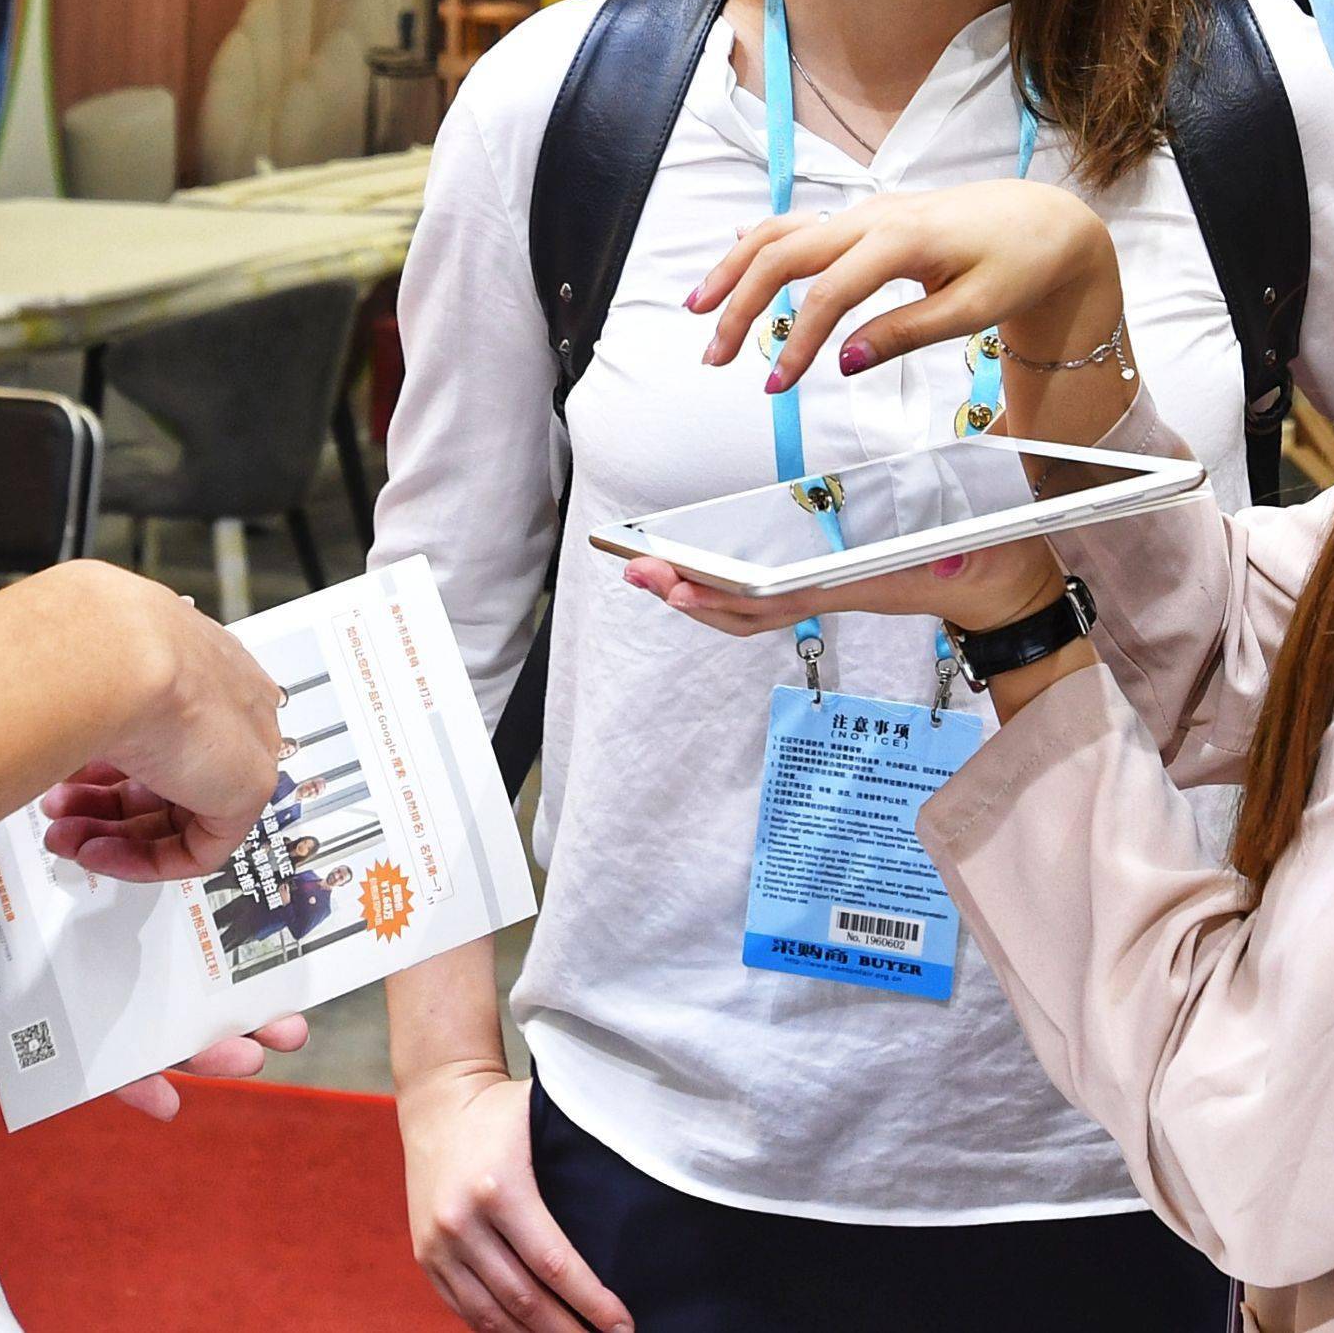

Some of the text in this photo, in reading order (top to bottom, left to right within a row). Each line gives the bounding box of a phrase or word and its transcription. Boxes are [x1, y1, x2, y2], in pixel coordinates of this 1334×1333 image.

[376, 714, 399, 756] Google
[830, 728, 908, 749] (NOTICE)
[831, 712, 910, 740] 注意事项
[846, 931, 905, 950] No. 1960602
[770, 938, 924, 976] 采购商 BUYER
